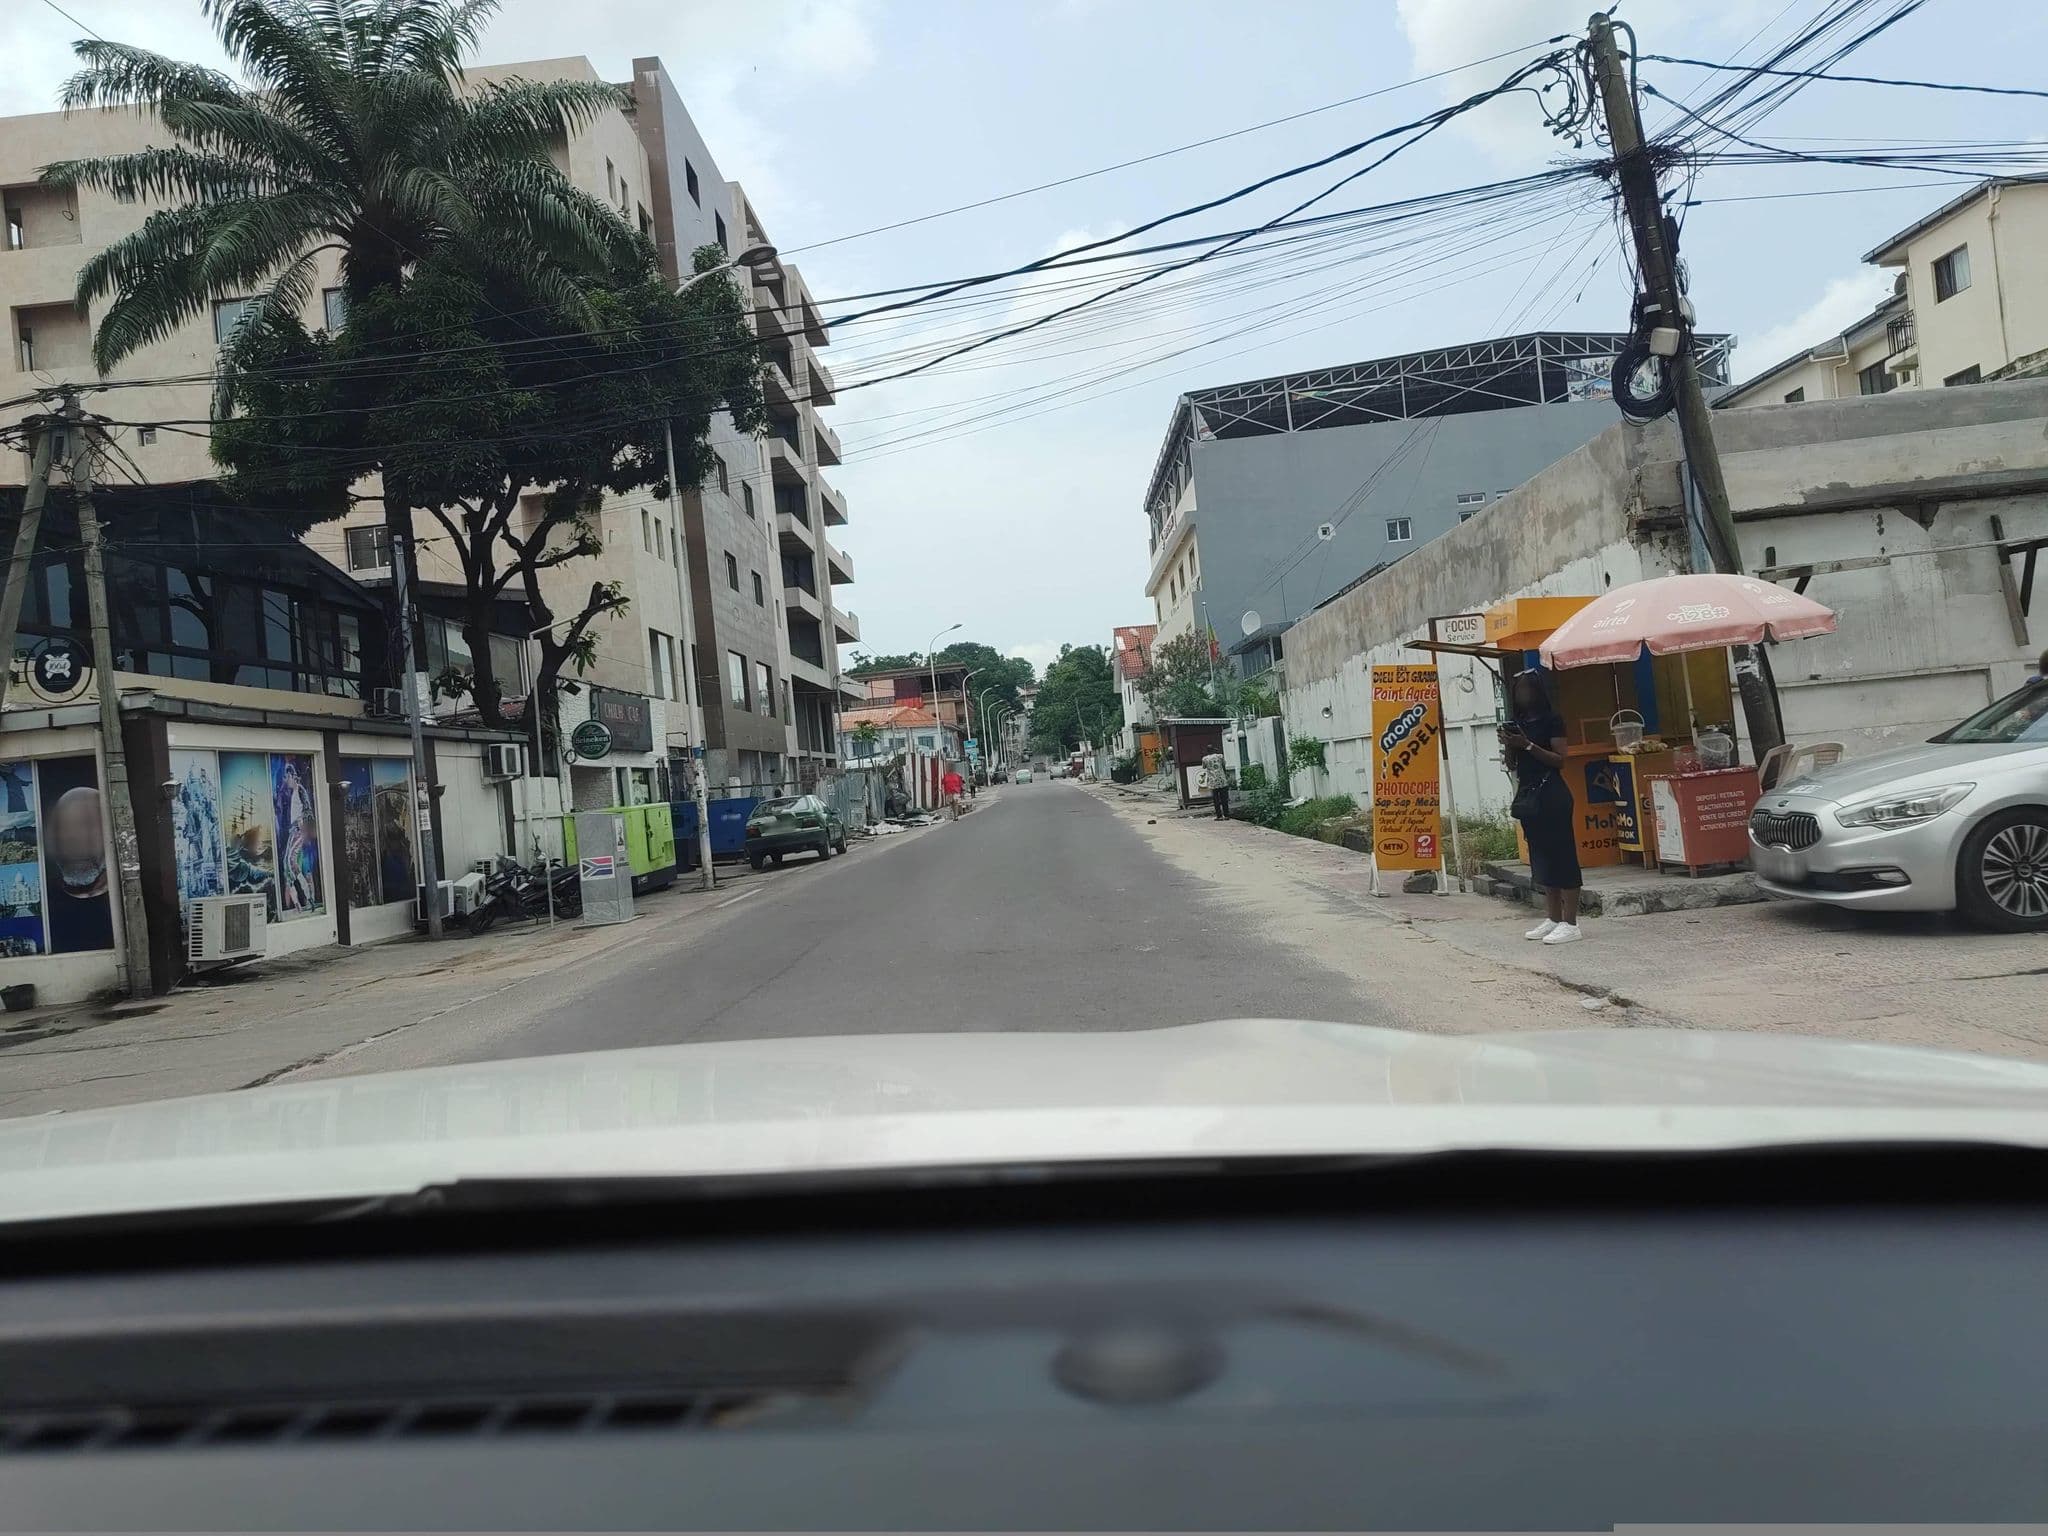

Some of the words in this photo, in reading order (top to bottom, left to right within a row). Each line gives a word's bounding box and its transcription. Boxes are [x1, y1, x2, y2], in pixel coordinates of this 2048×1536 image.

[1446, 619, 1477, 632] FOCUS
[1447, 633, 1475, 642] Service
[1373, 671, 1393, 683] DIEU
[1411, 671, 1437, 683] GRAND
[1373, 686, 1404, 701] Point
[1392, 723, 1438, 778] APPEL
[1375, 781, 1439, 796] PHOTOCOPIE
